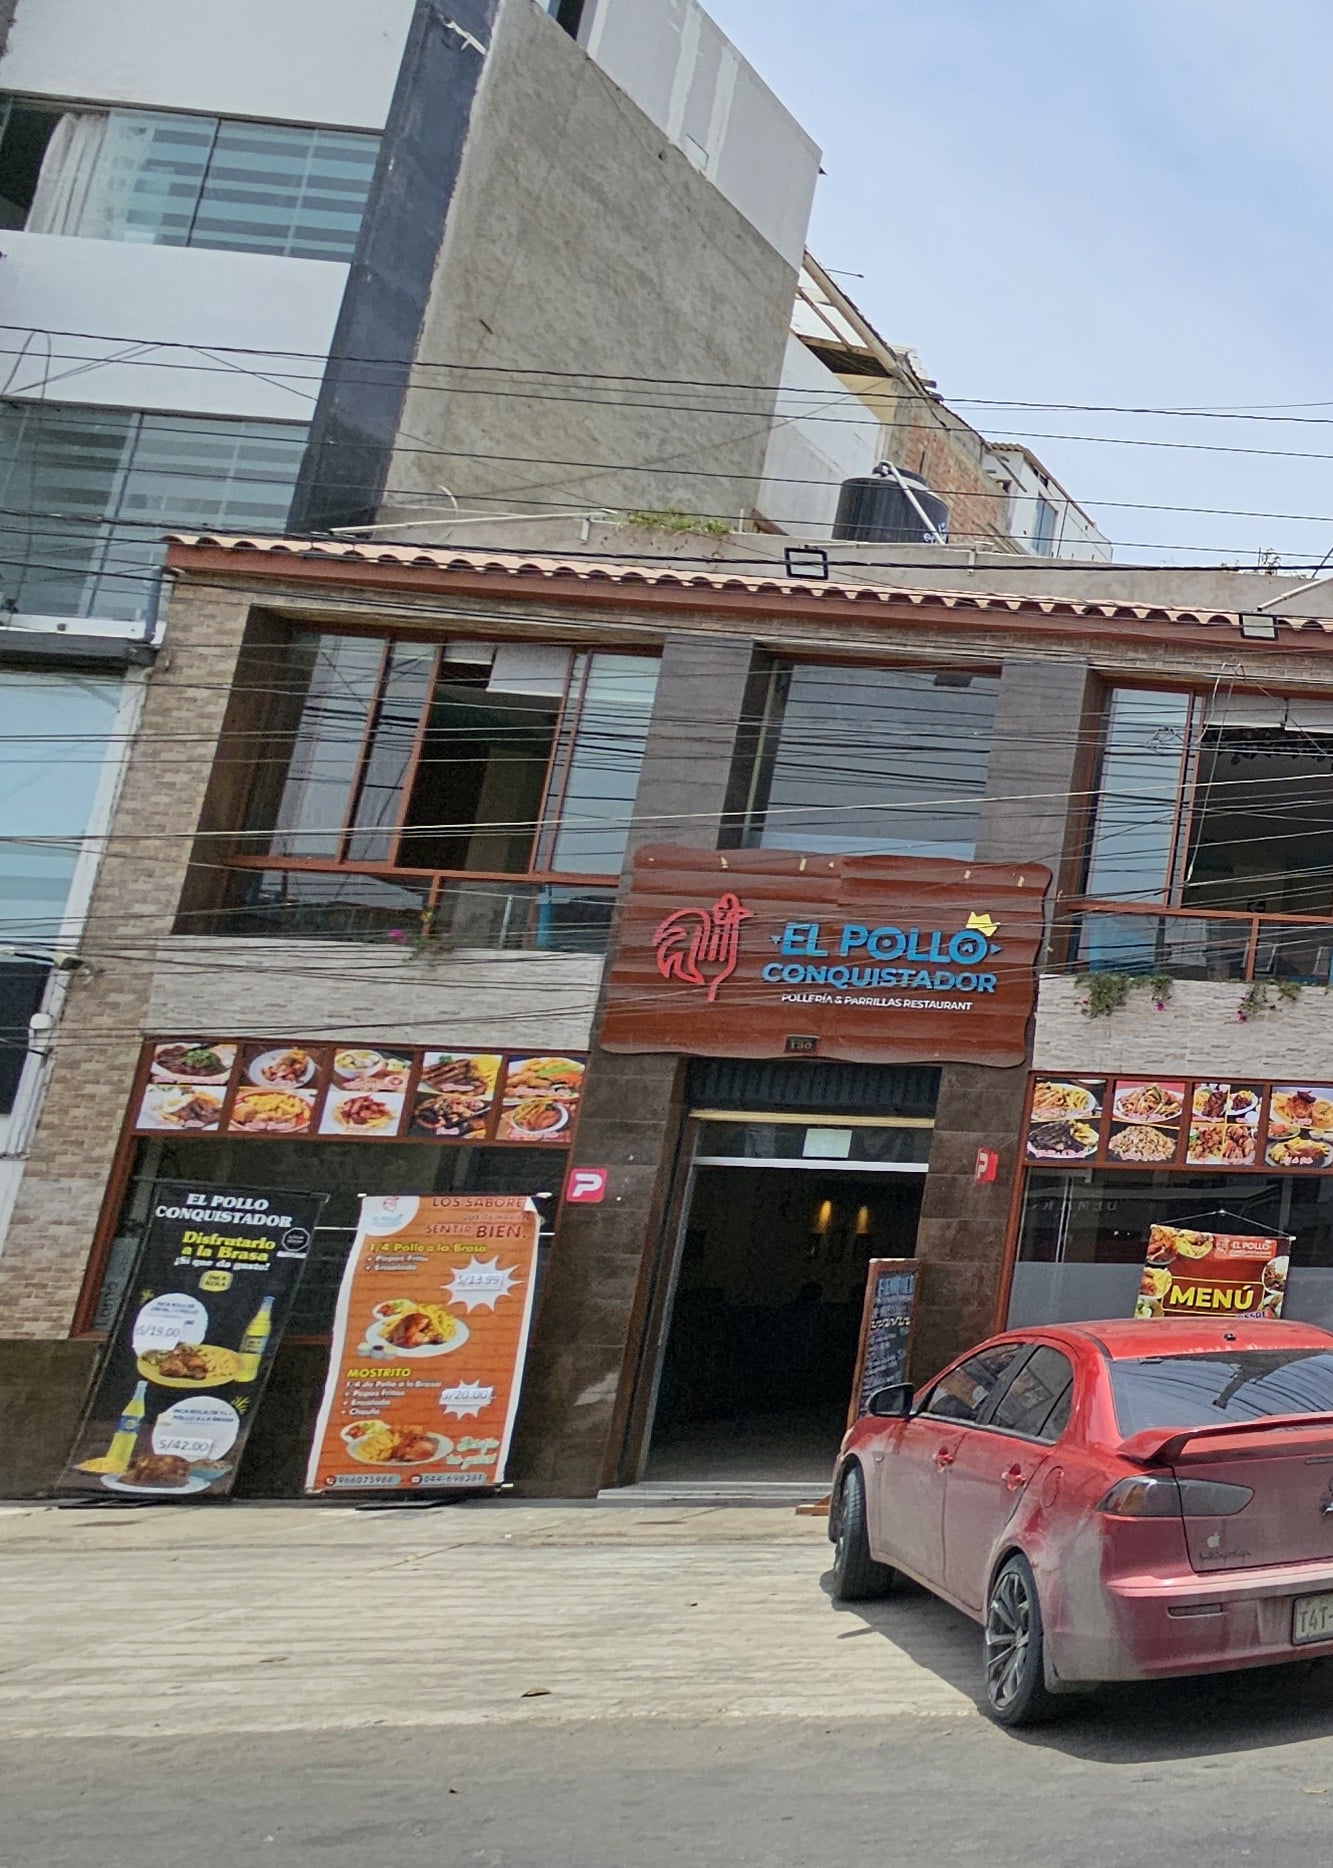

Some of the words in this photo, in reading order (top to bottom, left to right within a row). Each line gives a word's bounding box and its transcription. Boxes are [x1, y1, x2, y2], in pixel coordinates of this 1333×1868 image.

[781, 922, 829, 958] EL
[840, 924, 989, 965] POLLO
[762, 962, 997, 993] CONQUISTADOR
[781, 993, 833, 1004] POLLERÍA
[844, 996, 902, 1008] PARRILLAS
[903, 999, 973, 1011] RESTAURANT
[186, 1192, 208, 1206] EL
[210, 1195, 269, 1210] POLLO
[432, 1198, 460, 1208] LOS
[464, 1198, 526, 1208] SABORE
[155, 1205, 293, 1228] CONQUISTADOR
[426, 1223, 472, 1235] SENTIR
[476, 1225, 527, 1239] BIEN.
[181, 1230, 276, 1251] Disfrutarlo
[1232, 1240, 1242, 1249] EL
[1243, 1241, 1270, 1250] POLLO
[181, 1246, 193, 1256] a
[197, 1245, 213, 1258] la
[217, 1247, 269, 1261] Brasa
[1169, 1284, 1254, 1310] MENÚ
[348, 1368, 412, 1378] MOSTRITO
[159, 1439, 209, 1452] S/42.00
